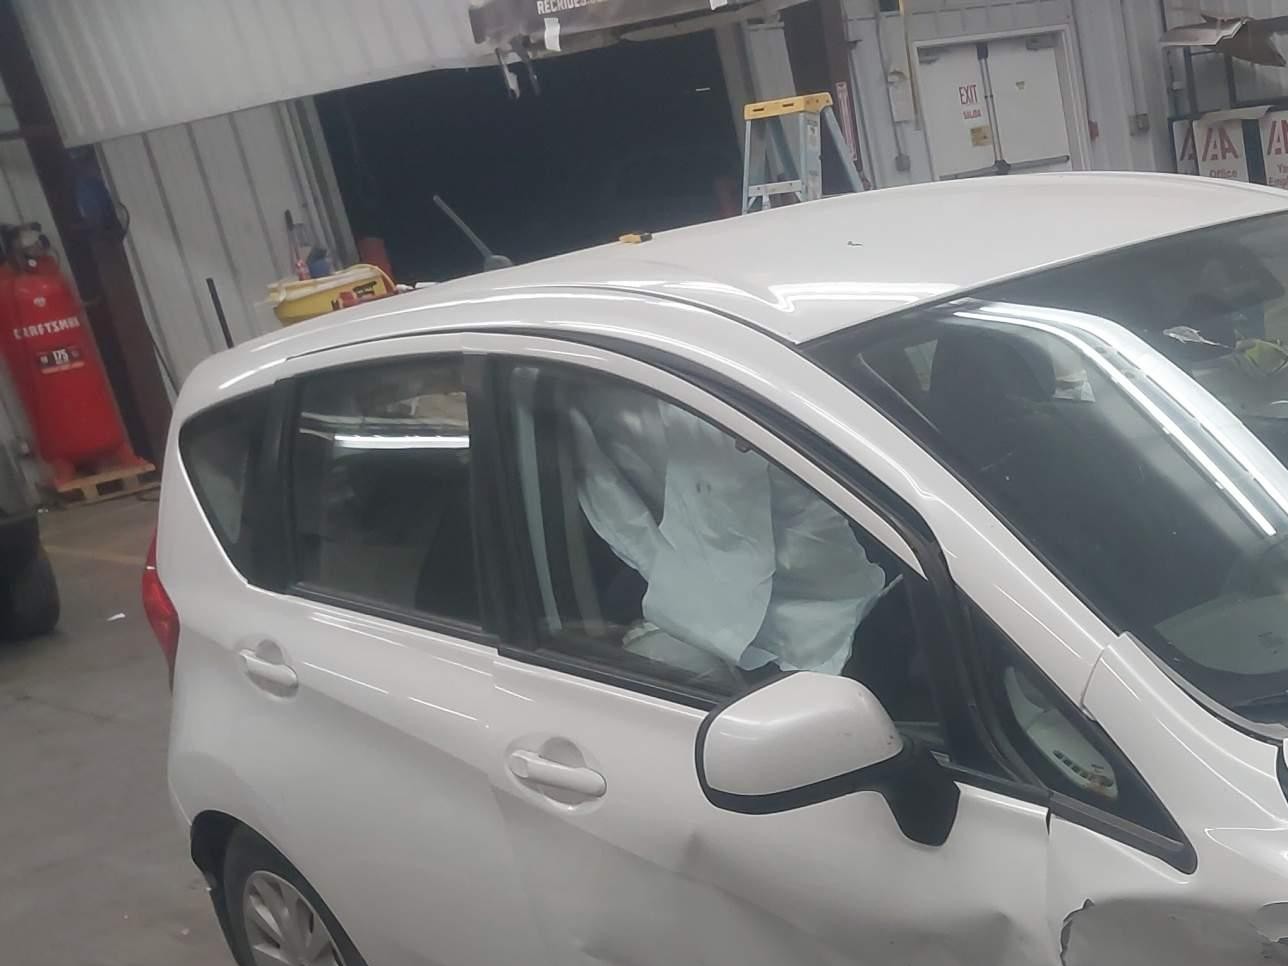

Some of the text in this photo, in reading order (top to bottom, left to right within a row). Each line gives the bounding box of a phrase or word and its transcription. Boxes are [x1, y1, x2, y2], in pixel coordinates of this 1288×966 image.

[958, 84, 978, 105] EXIT
[1208, 167, 1238, 178] Office
[12, 316, 81, 340] CRAFTSMAN
